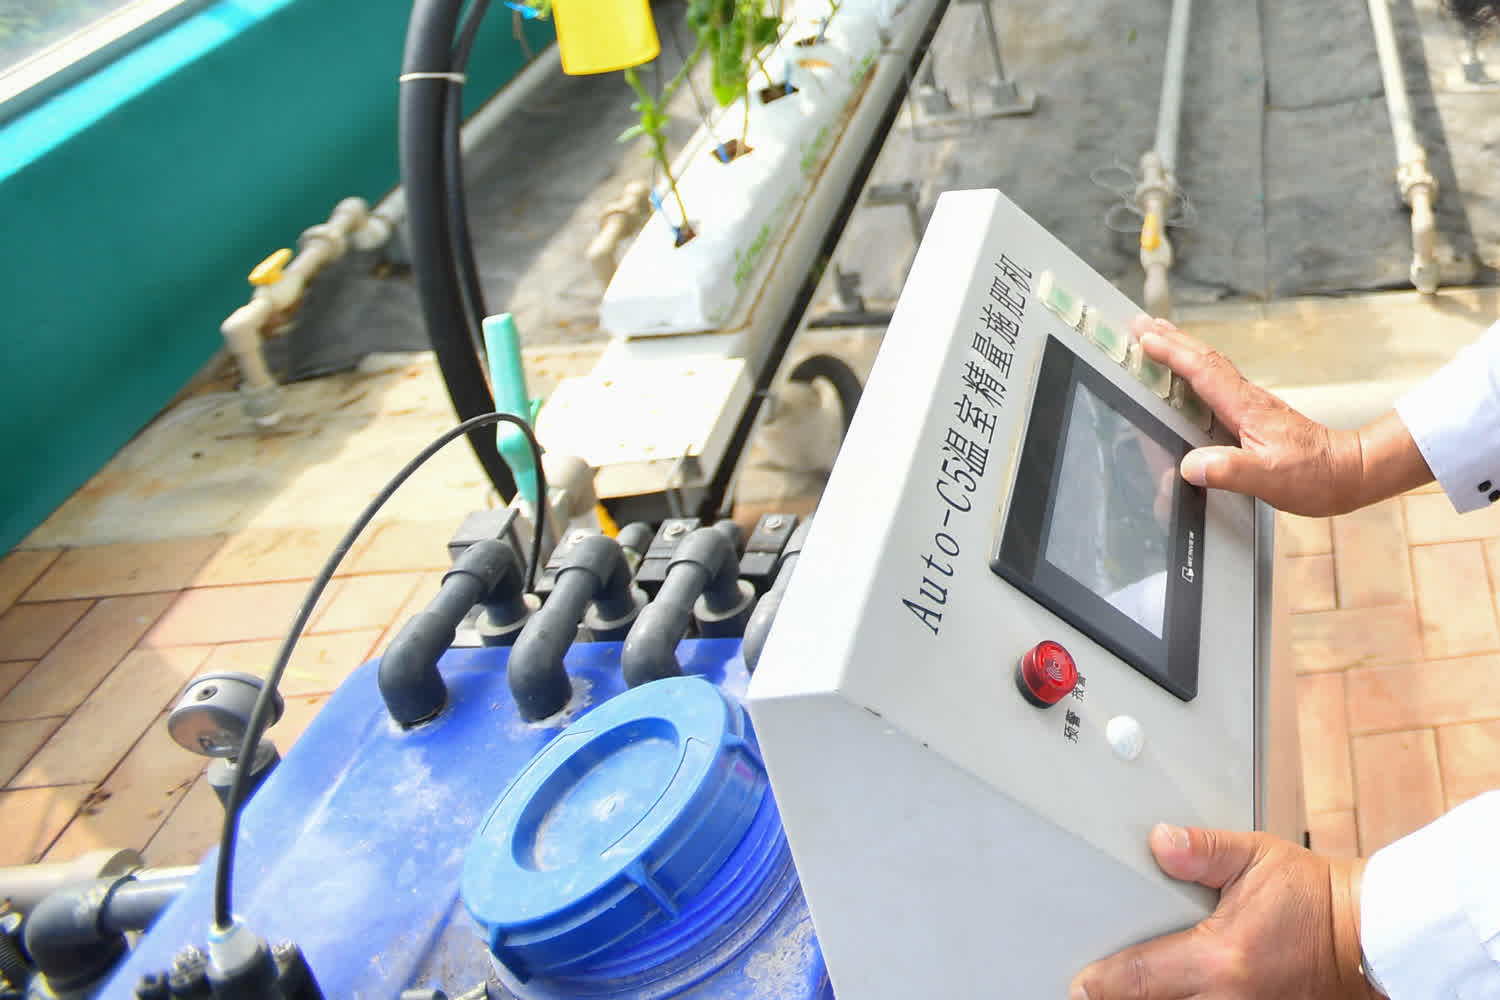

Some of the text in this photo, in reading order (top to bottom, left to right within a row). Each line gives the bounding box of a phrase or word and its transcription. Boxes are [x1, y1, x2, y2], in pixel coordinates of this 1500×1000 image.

[901, 253, 1033, 636] Auto-C5温室精量施肥机
